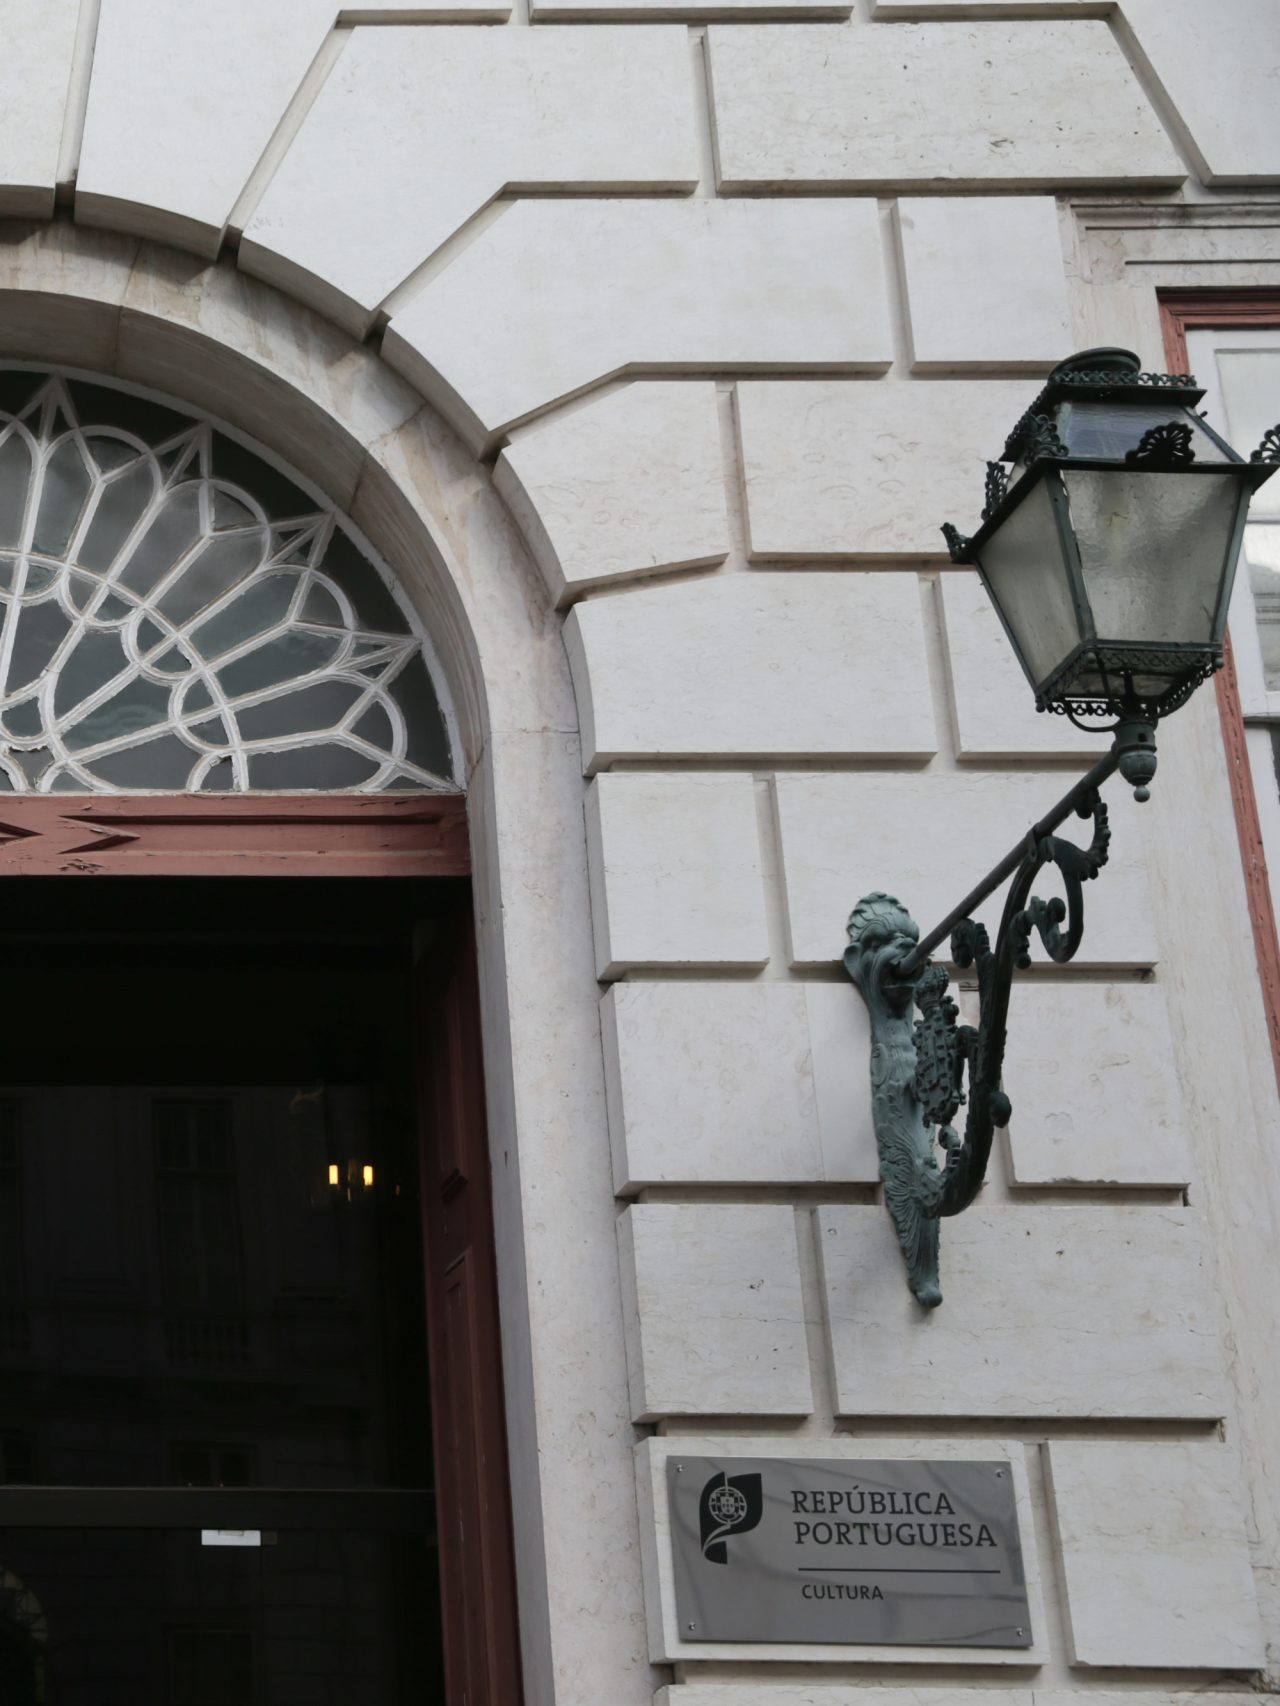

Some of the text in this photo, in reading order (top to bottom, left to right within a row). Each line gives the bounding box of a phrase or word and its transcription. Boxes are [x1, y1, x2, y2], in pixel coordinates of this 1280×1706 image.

[791, 1485, 956, 1516] REPÚBLICA
[794, 1521, 998, 1547] PORTUGUESA
[801, 1583, 884, 1600] CULTURA
